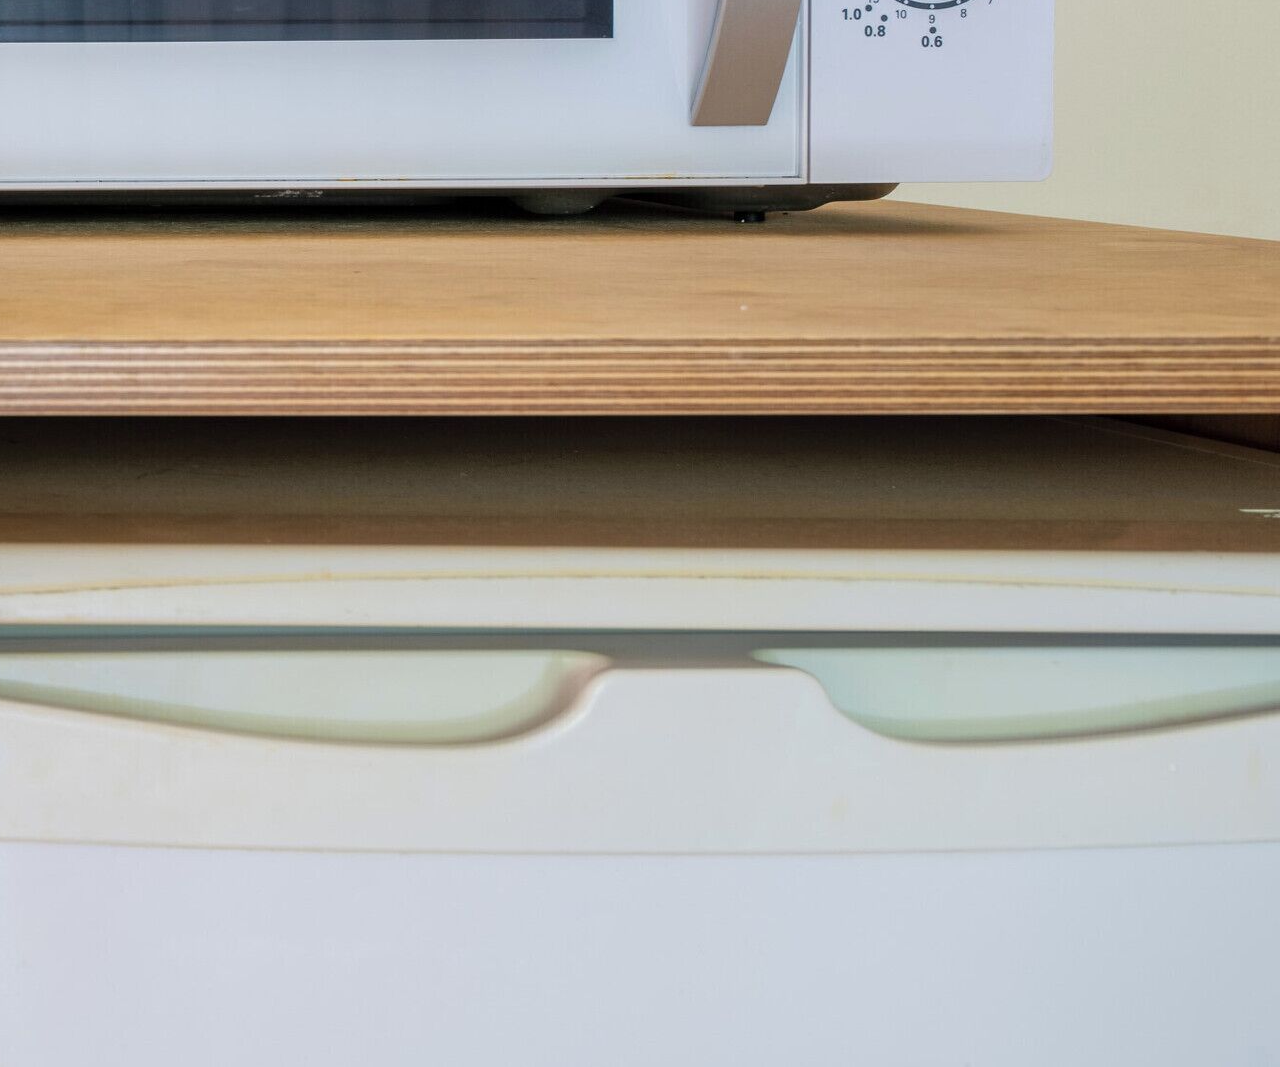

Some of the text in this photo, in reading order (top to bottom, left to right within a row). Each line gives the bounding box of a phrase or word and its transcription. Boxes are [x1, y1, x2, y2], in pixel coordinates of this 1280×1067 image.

[841, 8, 862, 21] 1.0
[895, 9, 907, 19] 10
[928, 14, 936, 24] 9
[960, 8, 967, 19] 8
[864, 24, 886, 38] 0.8
[921, 35, 943, 48] 0.6
